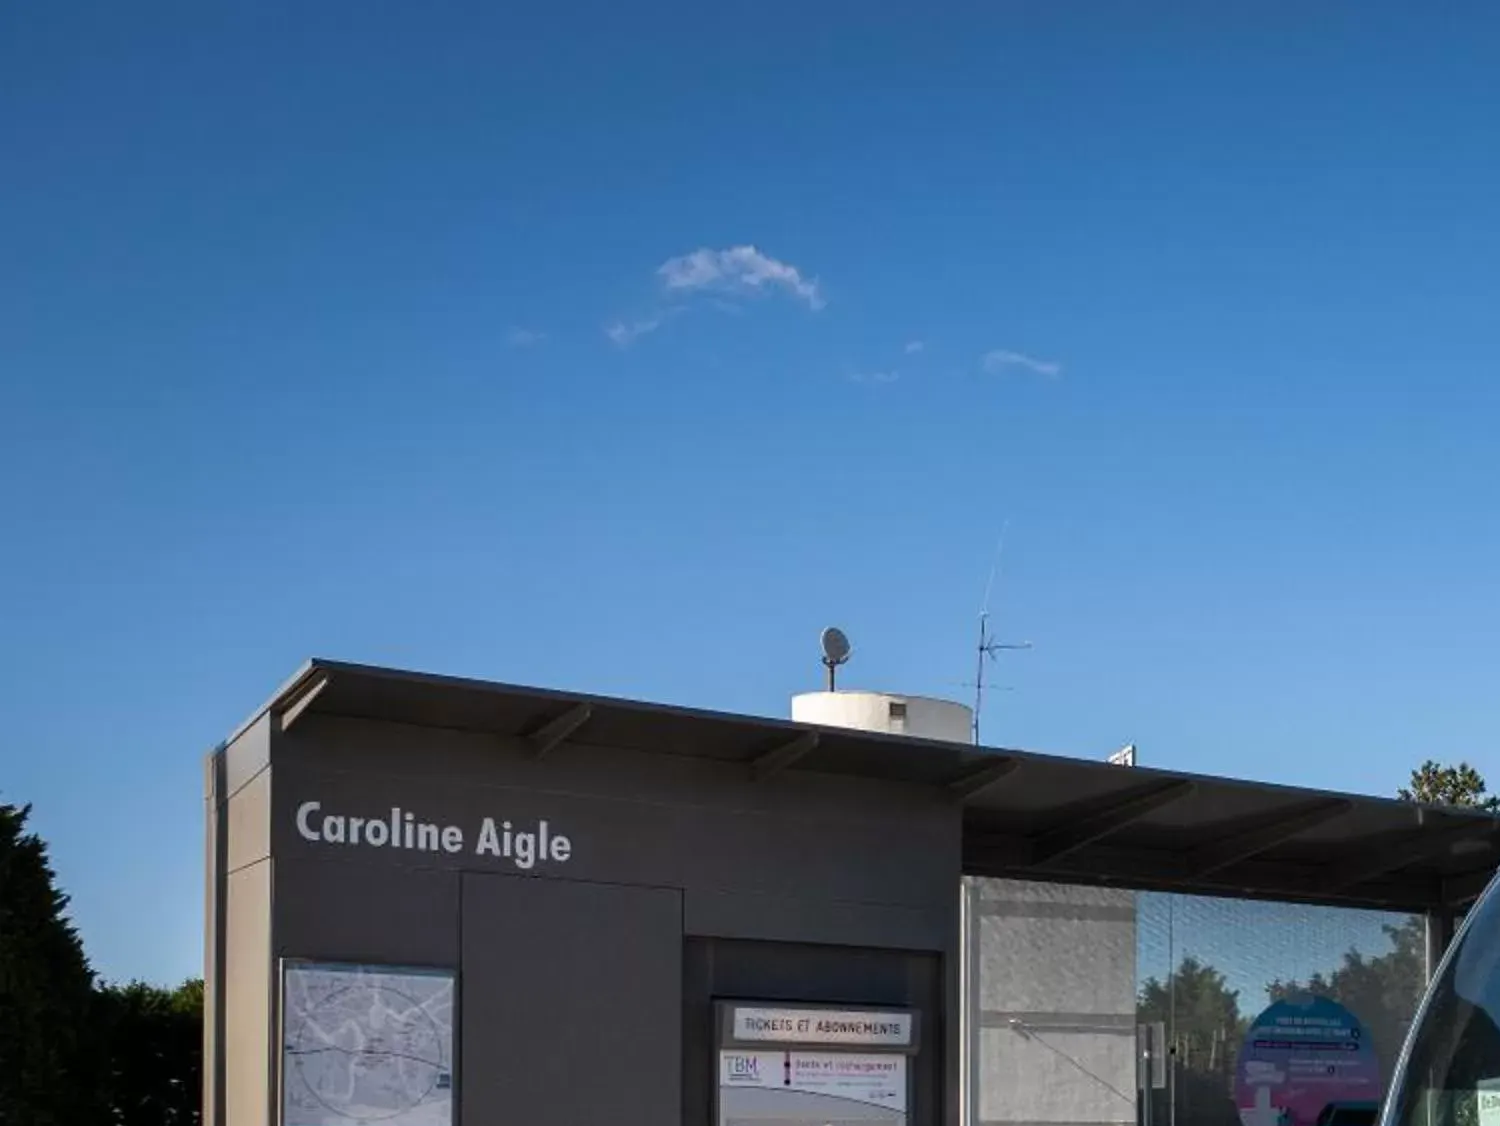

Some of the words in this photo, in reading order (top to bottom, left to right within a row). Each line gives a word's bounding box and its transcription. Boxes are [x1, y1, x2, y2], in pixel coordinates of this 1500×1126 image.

[296, 801, 464, 853] Caroline
[475, 818, 572, 869] Aigle
[745, 1017, 792, 1032] TICKETS
[797, 1019, 810, 1032] ET
[816, 1020, 901, 1035] ABONNEMENTS
[725, 1056, 758, 1074] TBM
